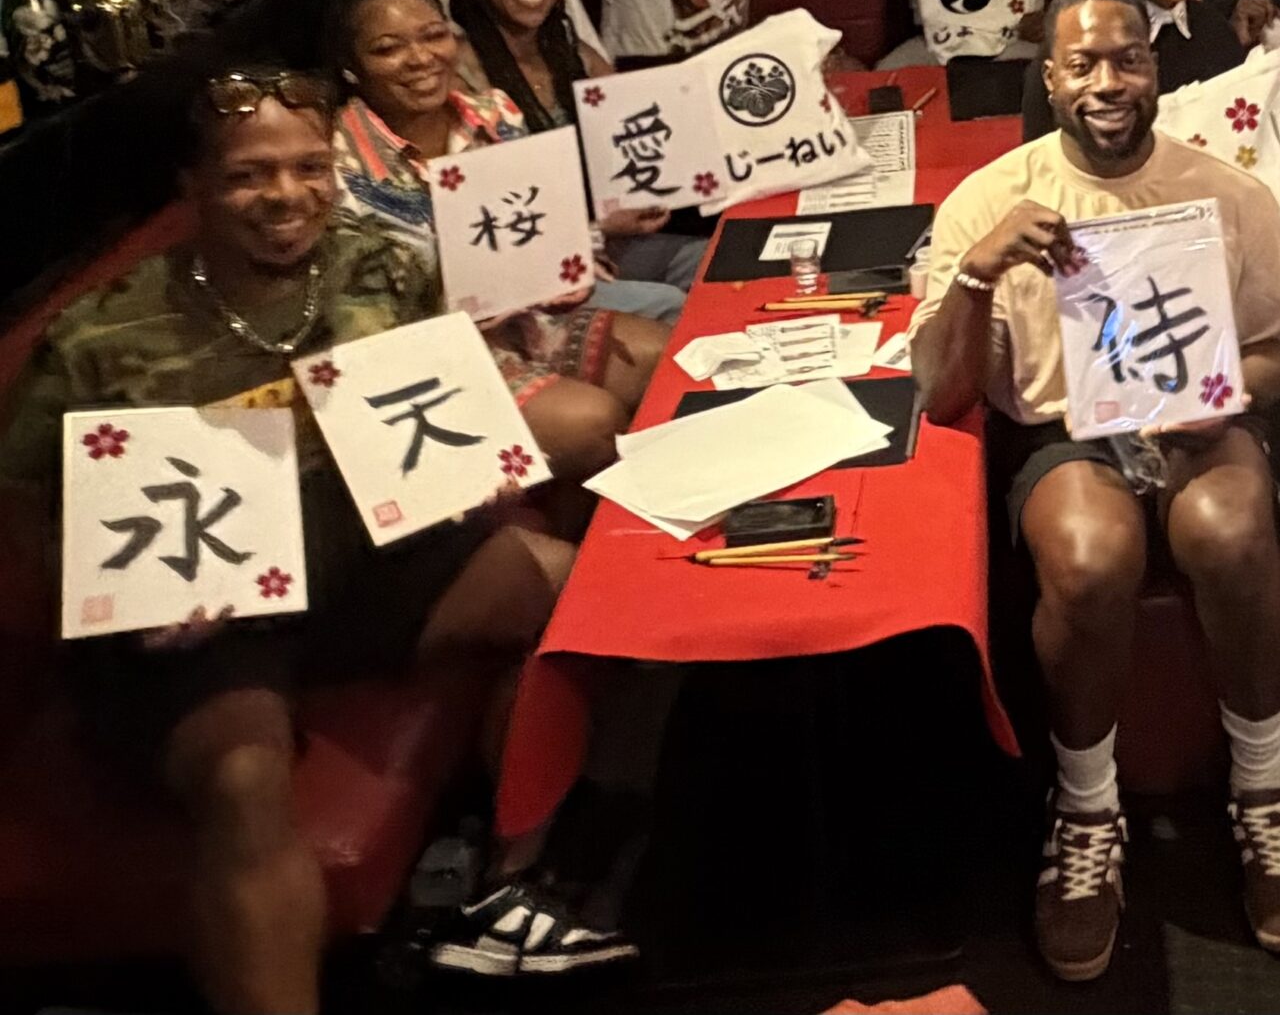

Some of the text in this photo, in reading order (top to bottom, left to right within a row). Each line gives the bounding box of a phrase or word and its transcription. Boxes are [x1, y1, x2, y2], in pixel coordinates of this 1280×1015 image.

[609, 101, 683, 197] 愛
[724, 128, 848, 183] じーねい
[468, 185, 548, 252] 桜
[1085, 275, 1212, 395] 侍
[362, 376, 487, 479] 天
[99, 456, 257, 583] 永
